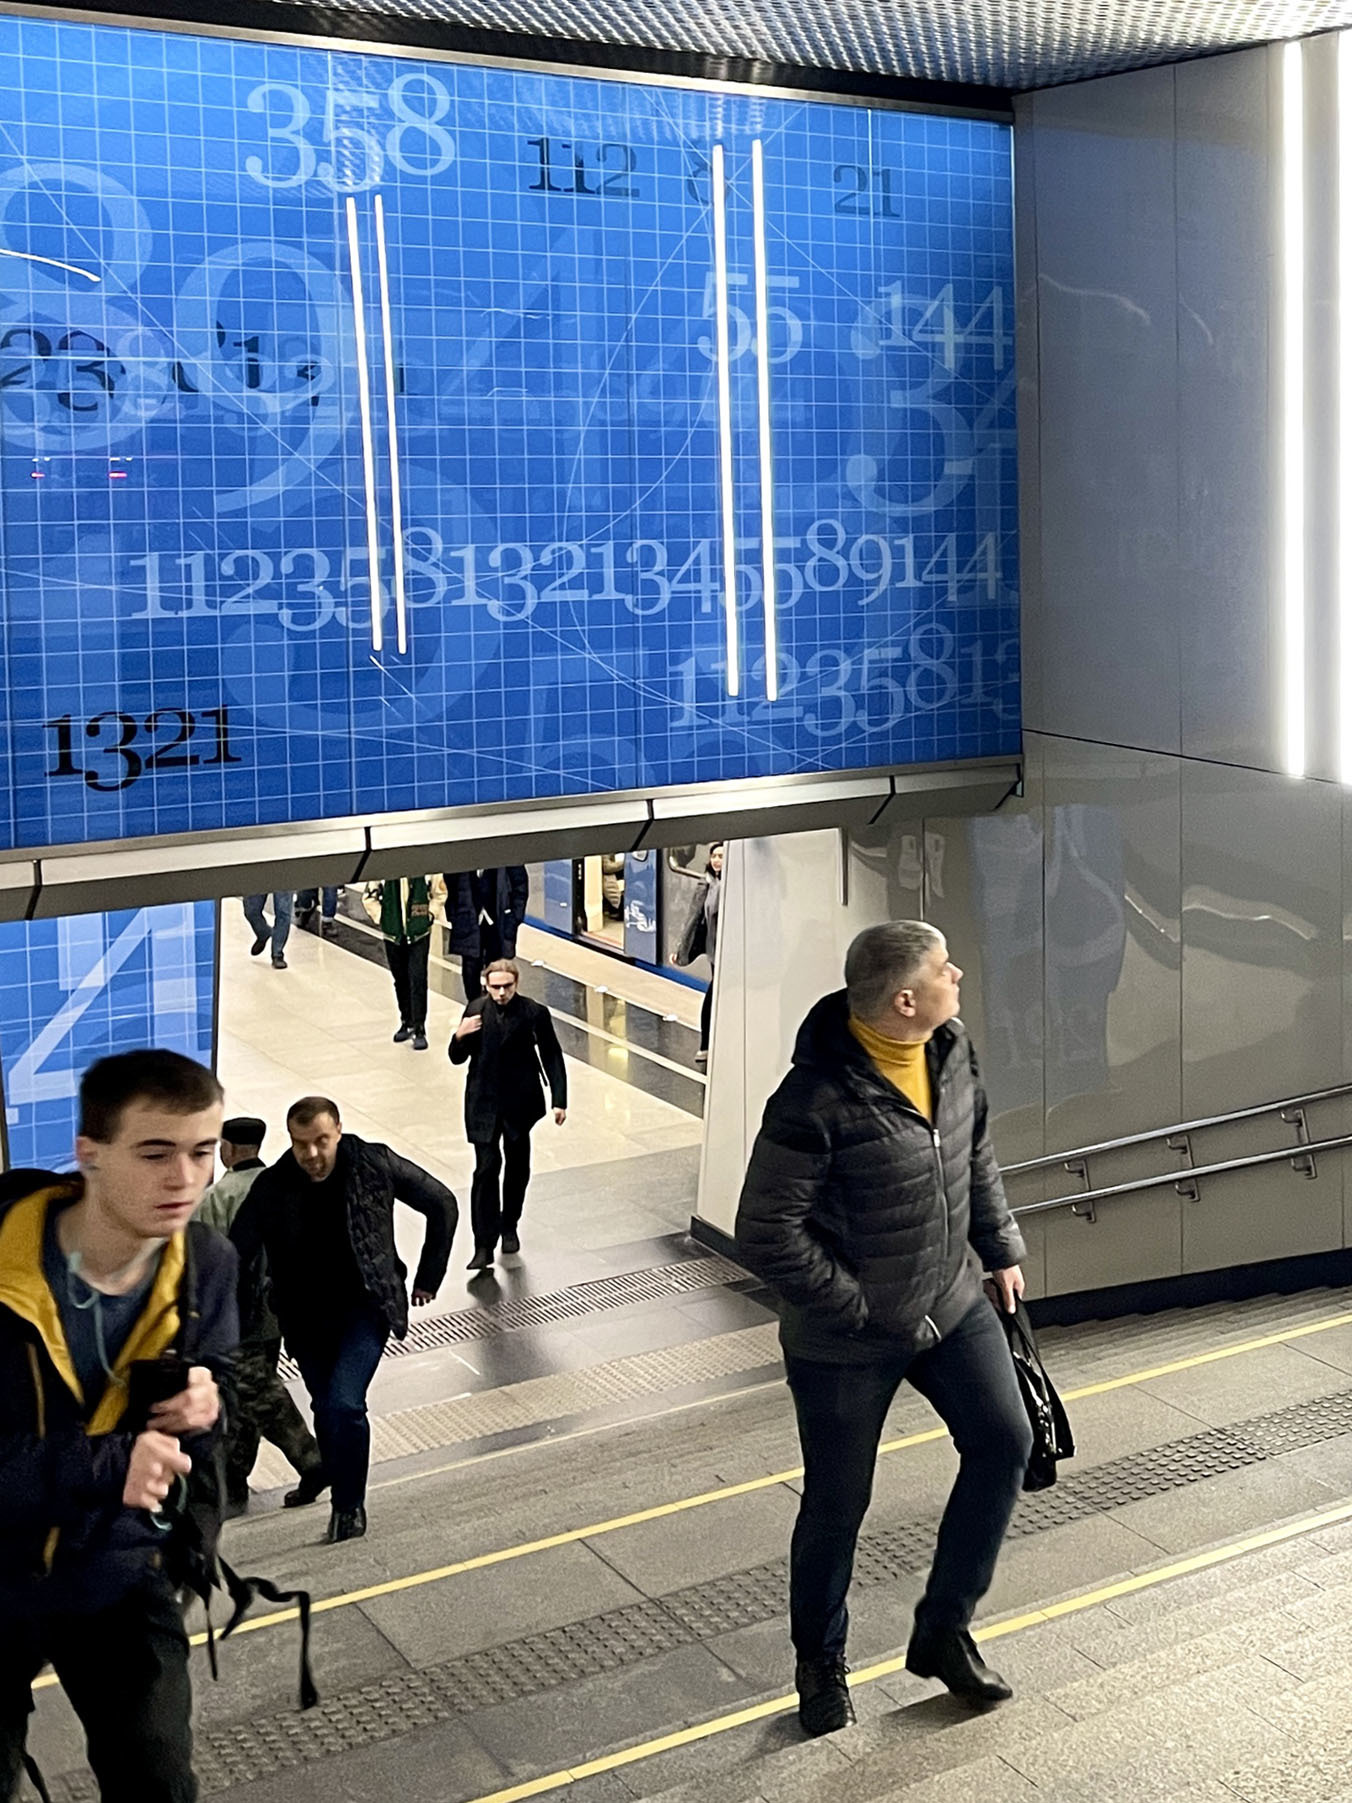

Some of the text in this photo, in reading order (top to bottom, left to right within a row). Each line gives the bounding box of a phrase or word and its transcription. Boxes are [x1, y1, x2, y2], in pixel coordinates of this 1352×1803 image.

[245, 72, 457, 193] 358
[527, 137, 641, 198] 112
[832, 164, 901, 218] 21
[876, 280, 1014, 371] 144
[43, 704, 243, 791] 1321
